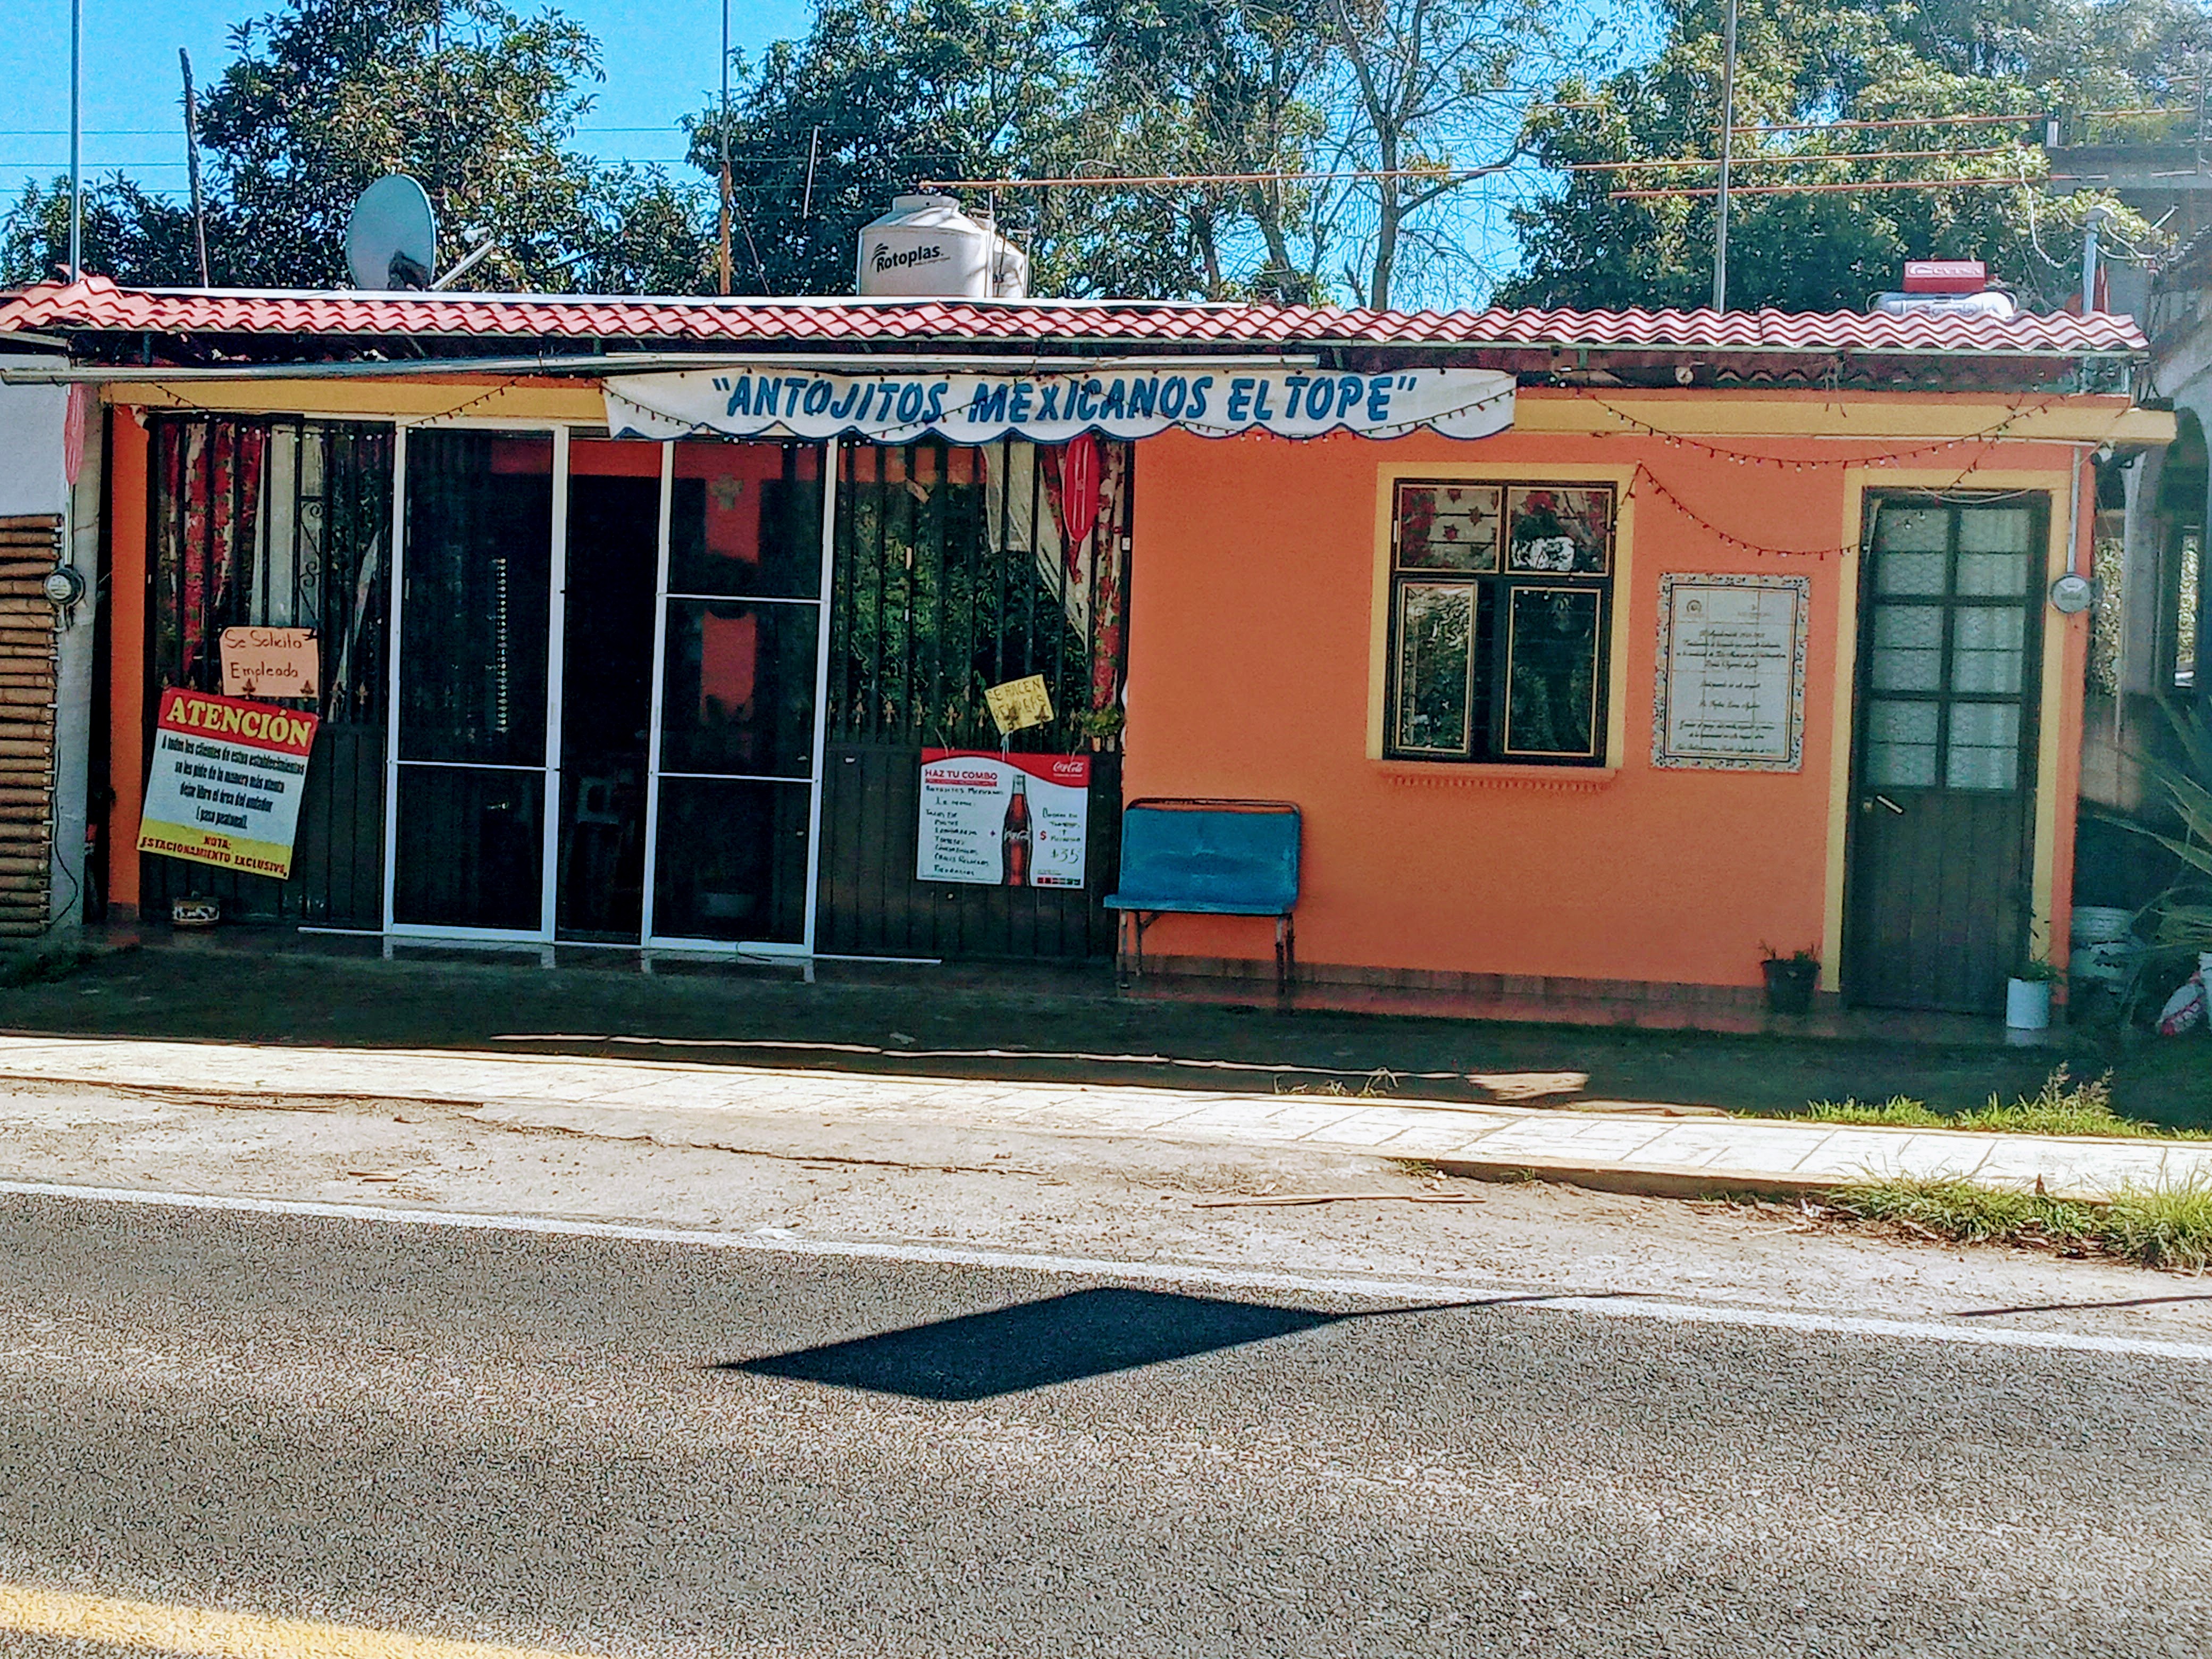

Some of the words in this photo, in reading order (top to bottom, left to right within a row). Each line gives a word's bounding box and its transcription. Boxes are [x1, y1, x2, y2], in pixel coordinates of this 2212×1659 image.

[876, 246, 940, 272] Rotoplas
[713, 376, 949, 423] "ANTOJITOS
[968, 375, 1213, 423] MEXICANOS
[1227, 378, 1273, 421] EL
[1285, 375, 1417, 421] TOPE"
[225, 630, 246, 649] Se
[166, 697, 312, 747] ATENCIÓN
[962, 771, 998, 780] COMBO
[142, 836, 231, 863] ESTACIONAMIENTO
